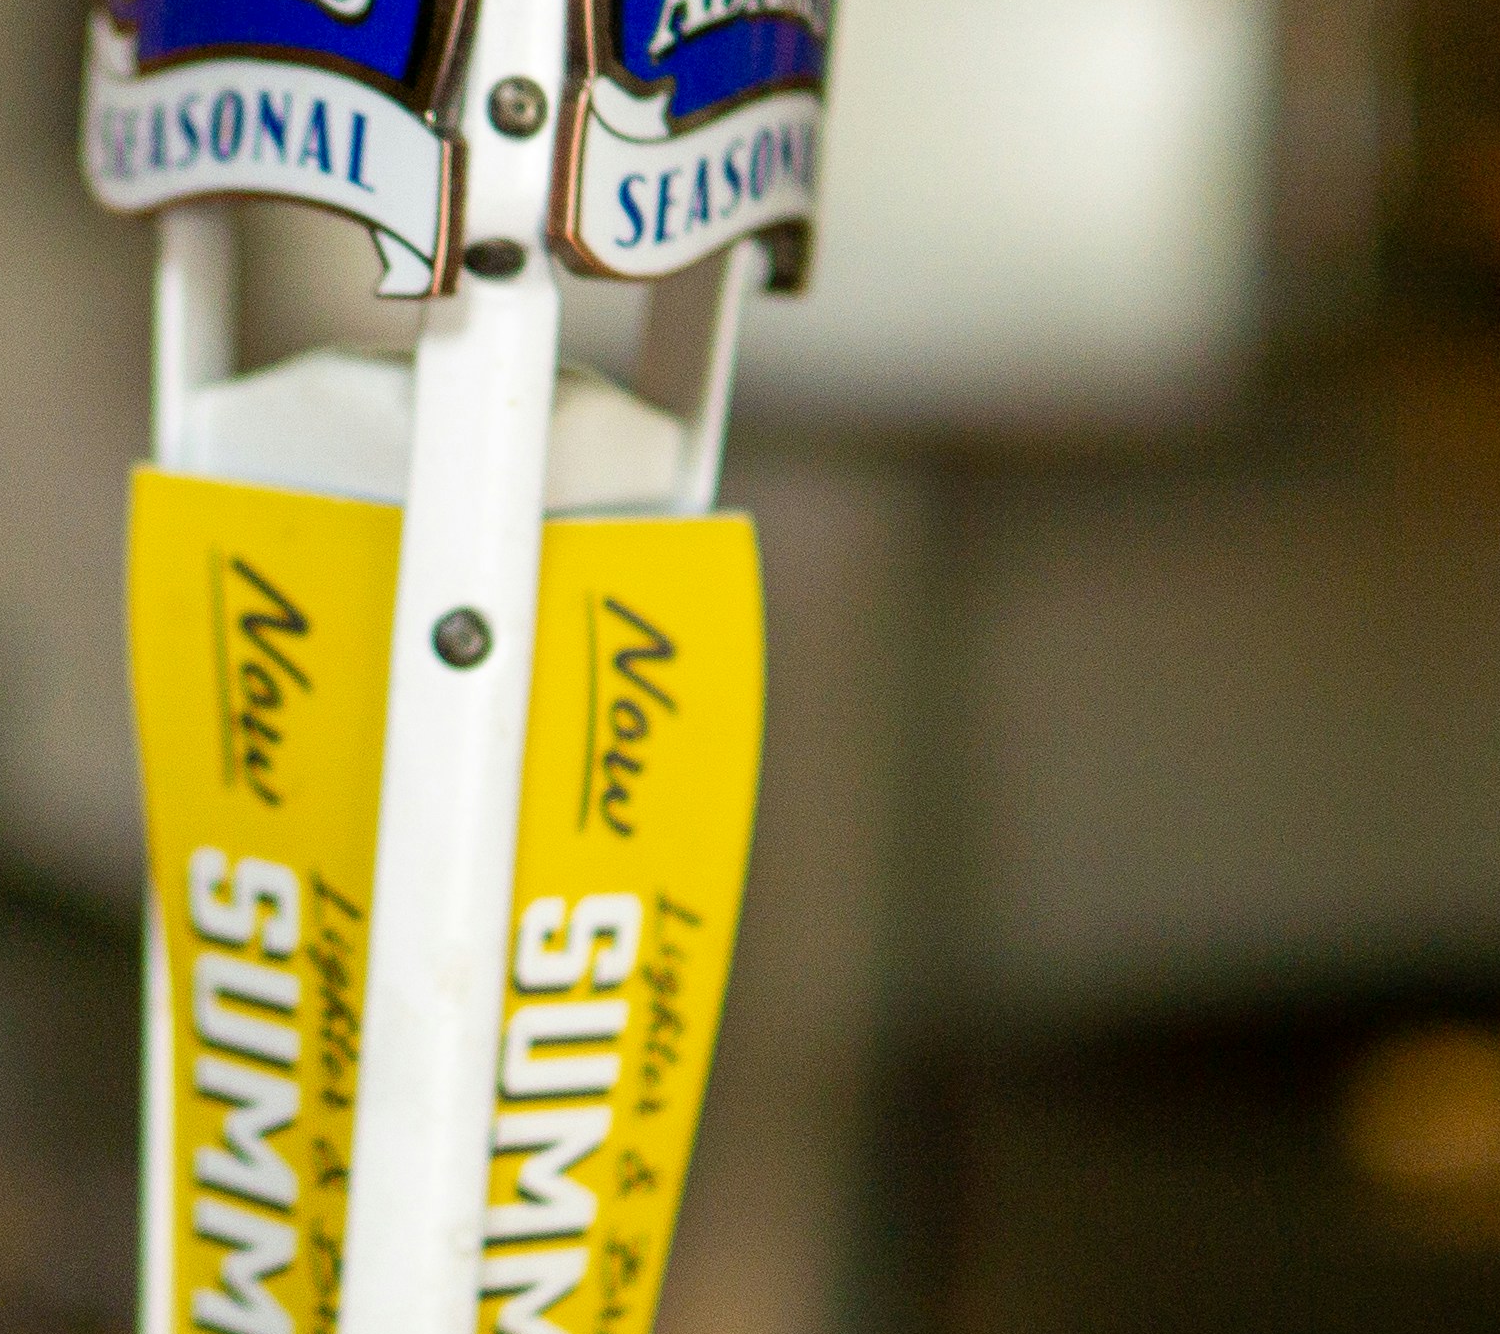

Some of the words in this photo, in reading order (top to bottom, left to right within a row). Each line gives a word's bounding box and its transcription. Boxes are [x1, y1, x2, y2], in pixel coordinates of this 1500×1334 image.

[614, 123, 814, 249] SEASON
[231, 556, 315, 807] Now
[599, 597, 679, 837] Now
